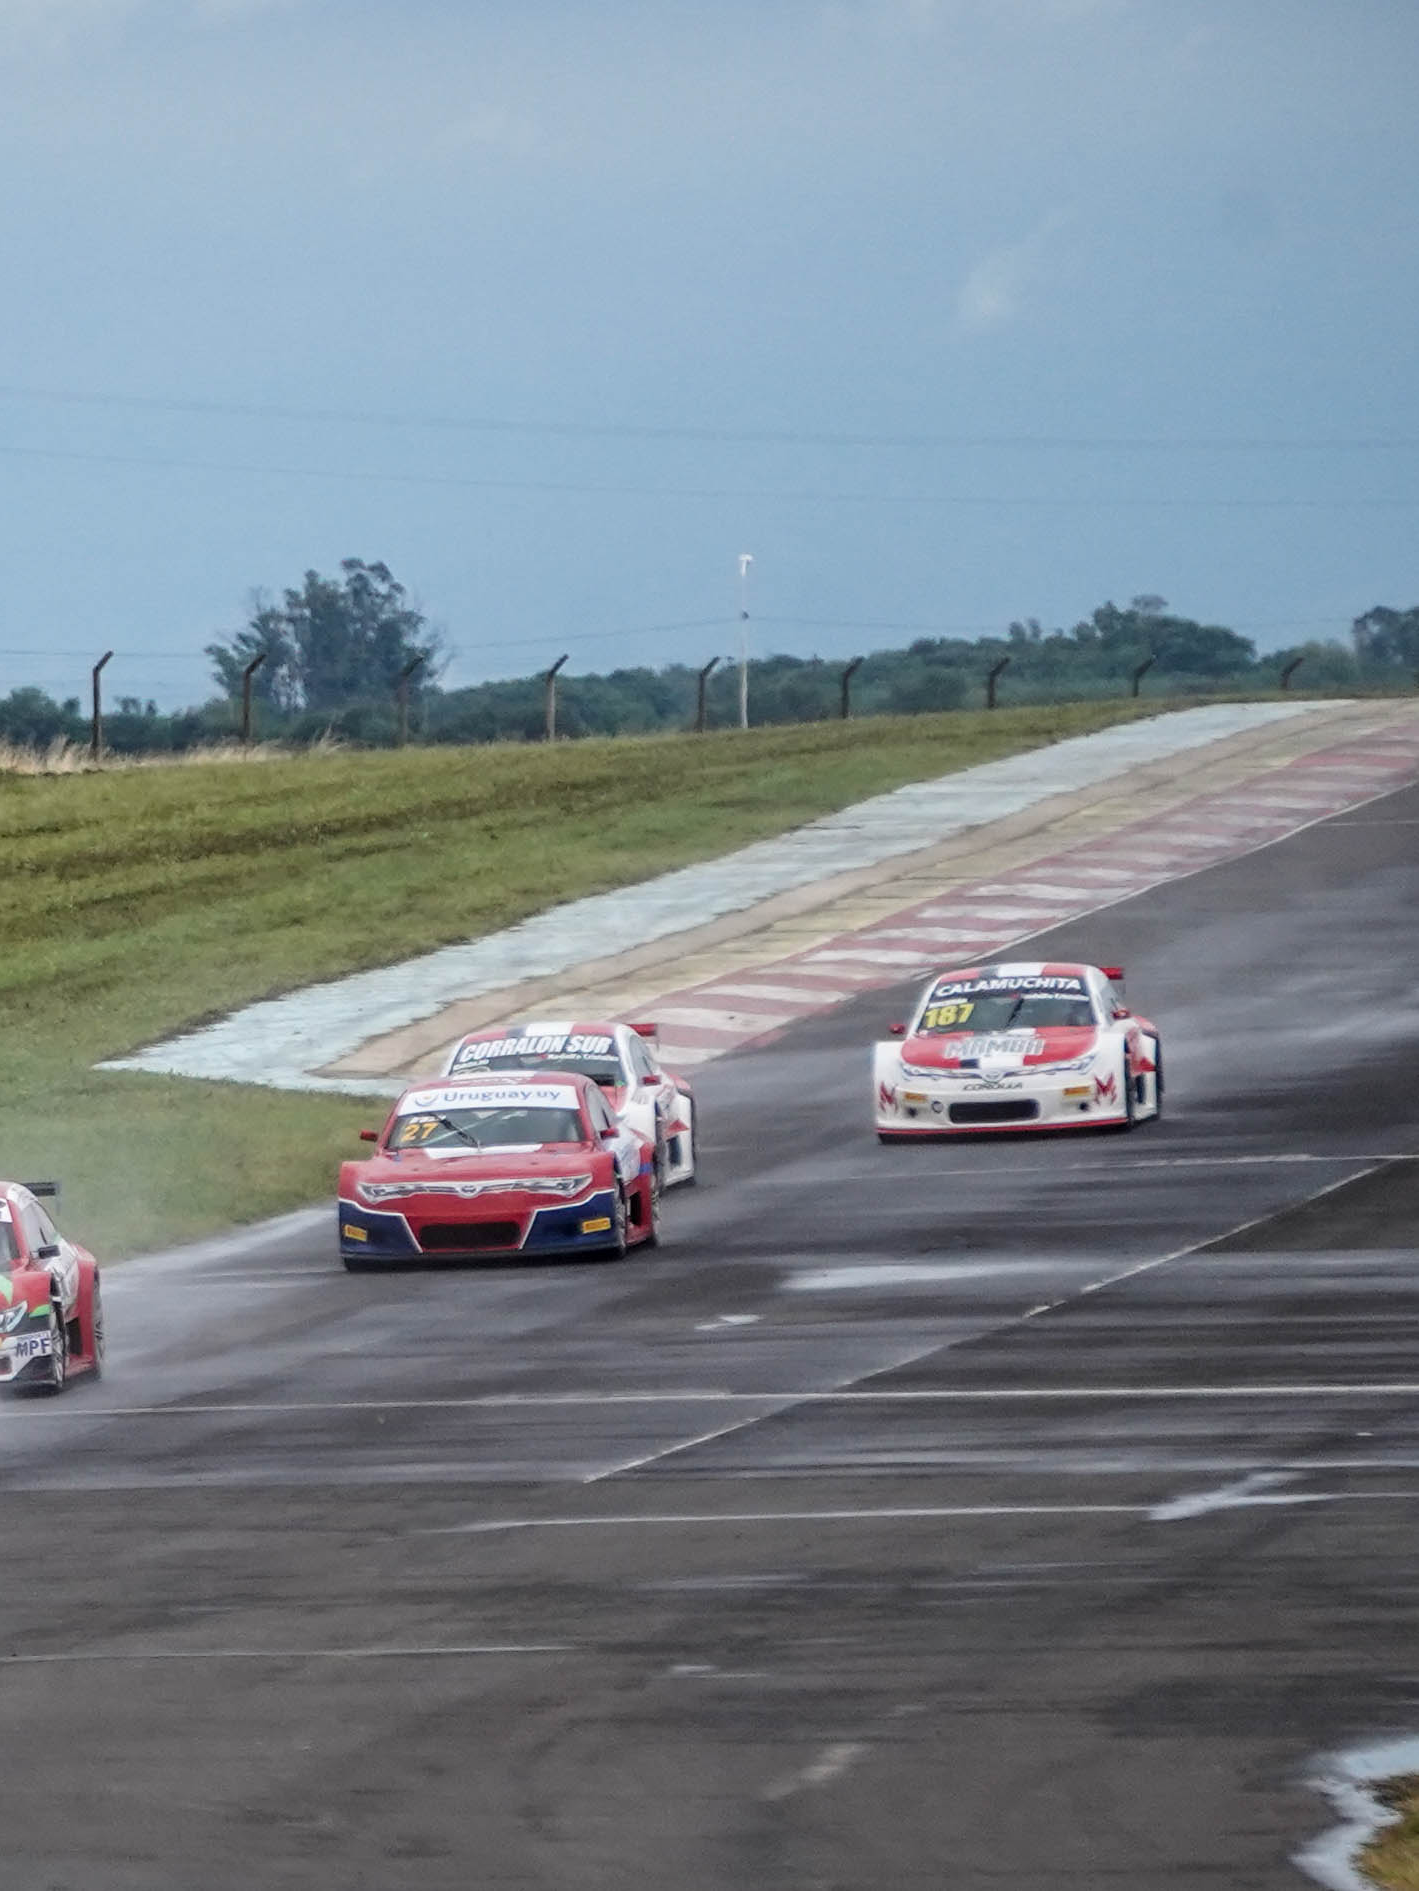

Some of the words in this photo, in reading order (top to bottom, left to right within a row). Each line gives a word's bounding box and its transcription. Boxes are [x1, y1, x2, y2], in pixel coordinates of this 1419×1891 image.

[936, 977, 1082, 997] CALAMUCHITA
[925, 1004, 975, 1028] 187
[459, 1036, 565, 1062] CORRALON
[566, 1035, 613, 1054] SUR
[402, 1122, 439, 1142] 27
